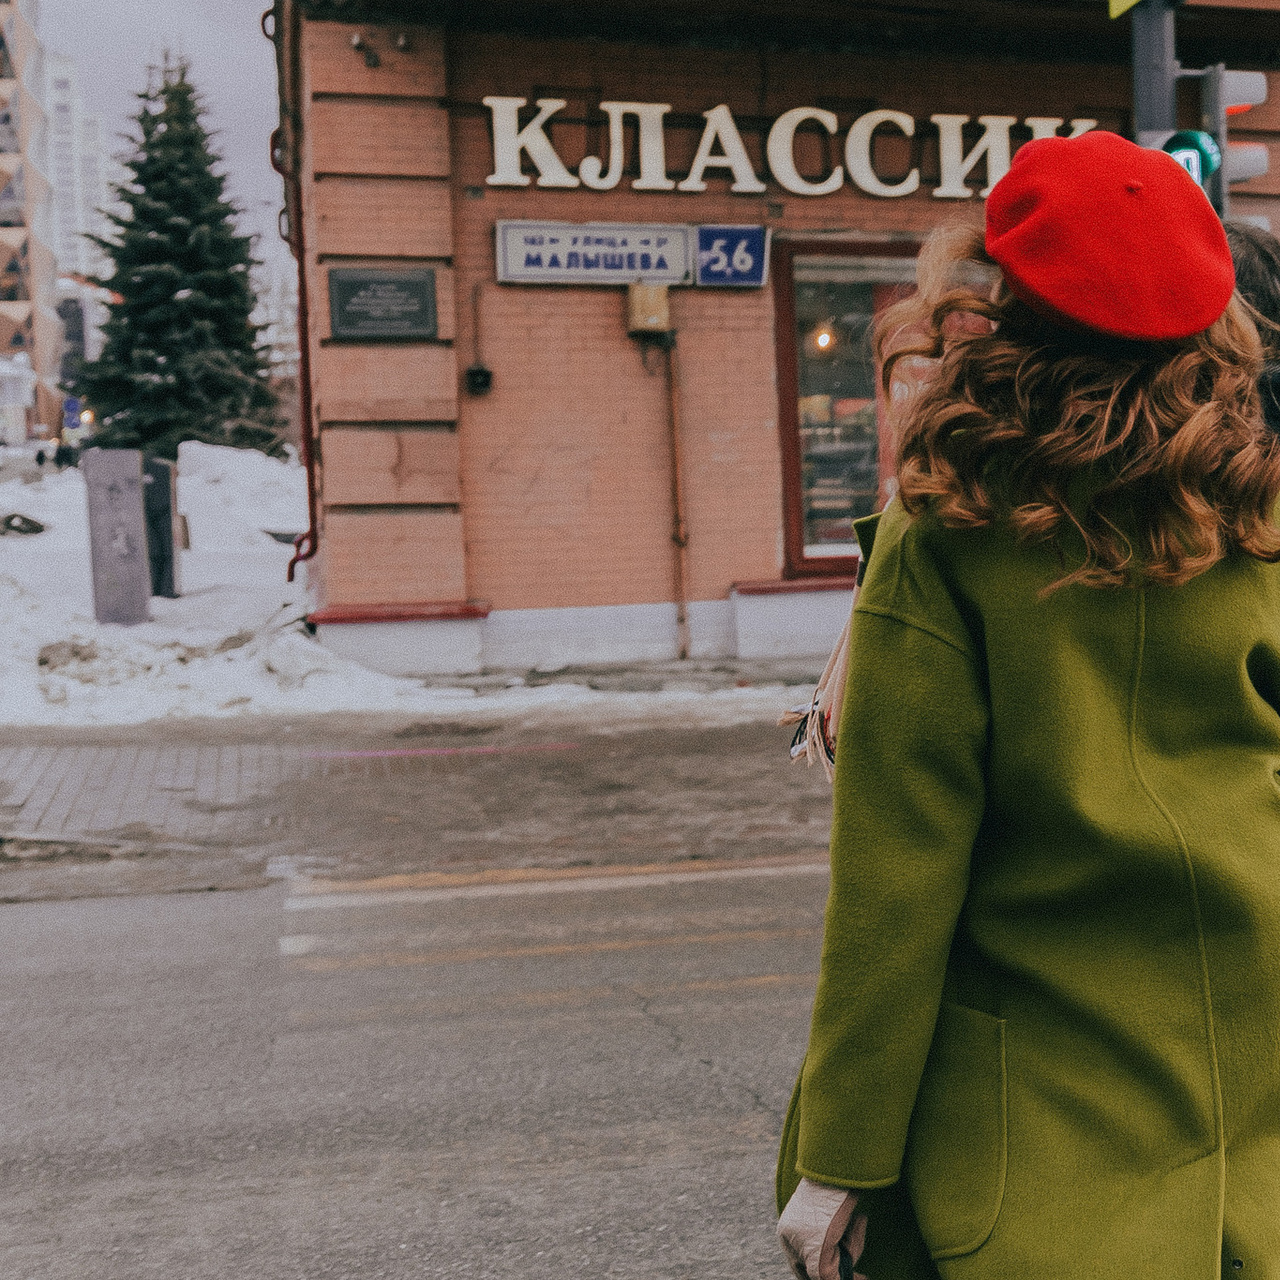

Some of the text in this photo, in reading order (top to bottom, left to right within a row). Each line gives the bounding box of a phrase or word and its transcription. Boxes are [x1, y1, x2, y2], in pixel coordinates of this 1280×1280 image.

[483, 96, 1098, 197] КЛАССИ
[523, 252, 668, 270] МАЛЫШЕВА
[710, 238, 753, 272] 56
